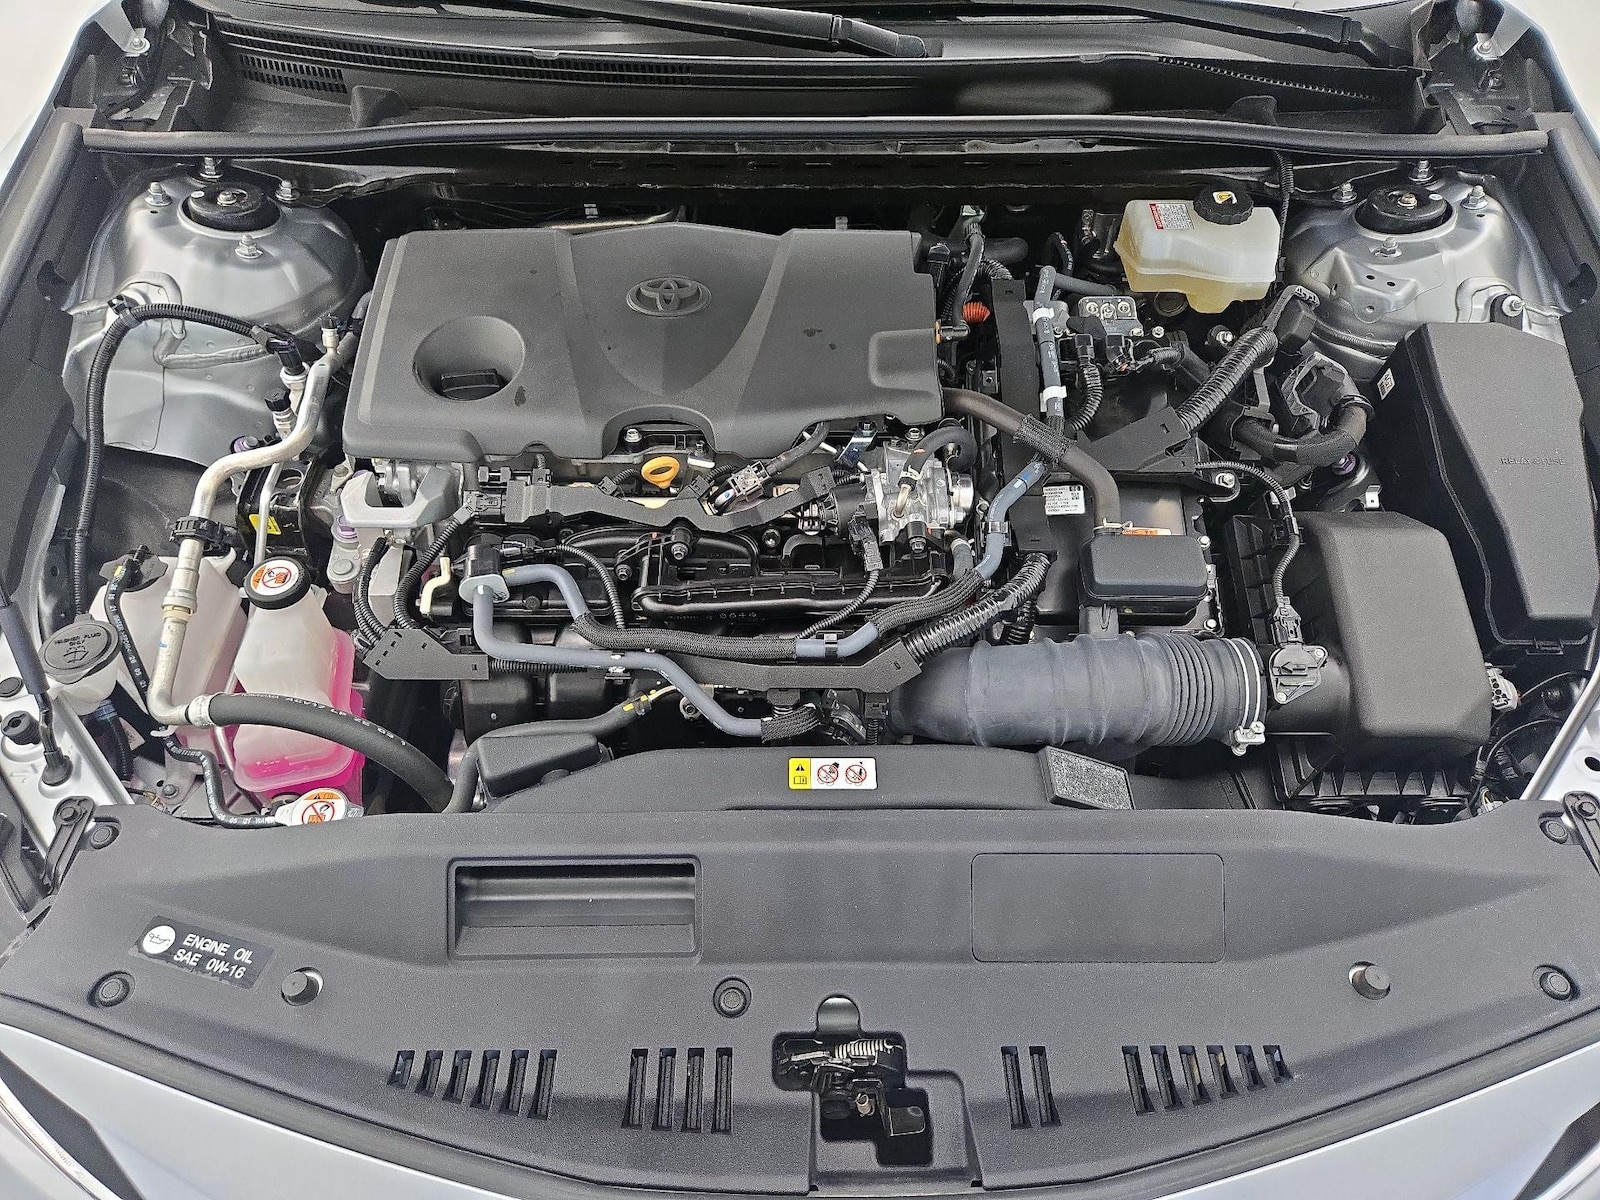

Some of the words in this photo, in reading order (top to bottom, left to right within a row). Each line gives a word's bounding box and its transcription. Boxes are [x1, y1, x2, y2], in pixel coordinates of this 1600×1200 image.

[173, 948, 203, 967] SAE
[205, 958, 247, 980] 0W-16
[182, 933, 231, 957] ENGINE
[233, 947, 253, 964] OIL
